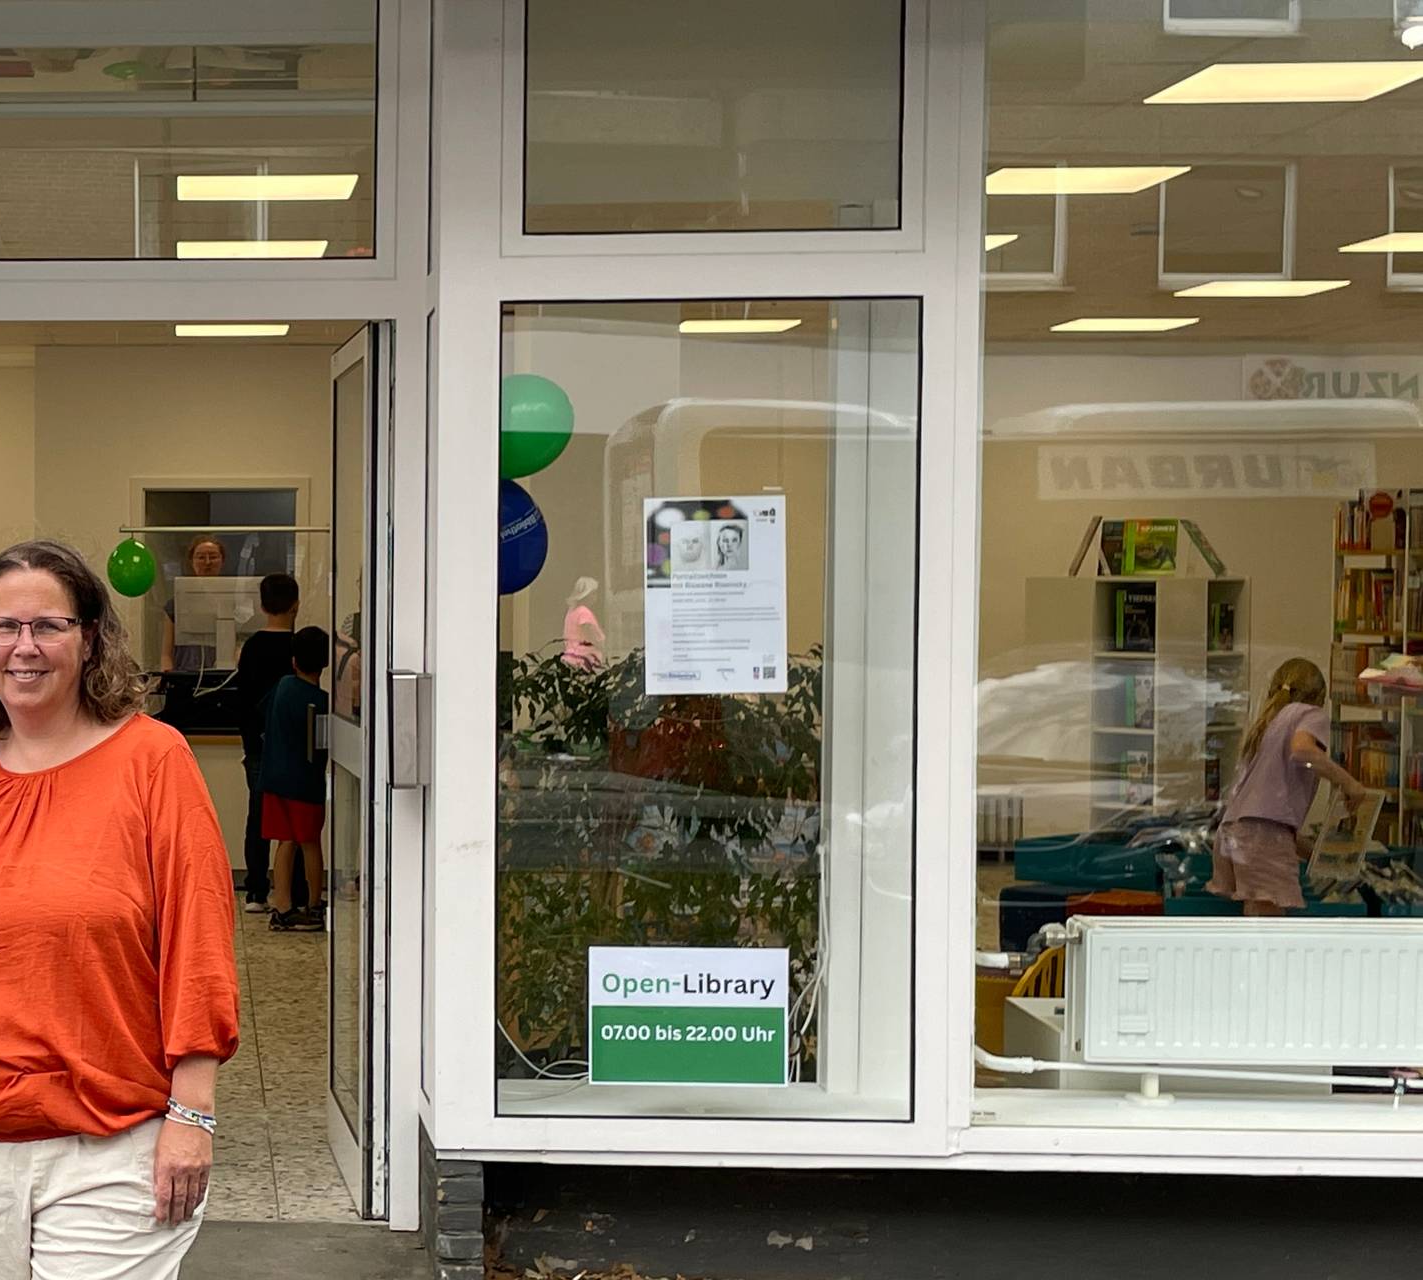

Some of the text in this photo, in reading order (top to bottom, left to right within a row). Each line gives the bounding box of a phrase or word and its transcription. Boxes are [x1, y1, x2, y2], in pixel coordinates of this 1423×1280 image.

[601, 972, 776, 1000] Open-Library
[600, 1024, 776, 1042] 07.00 bis 22.00 Uhr
